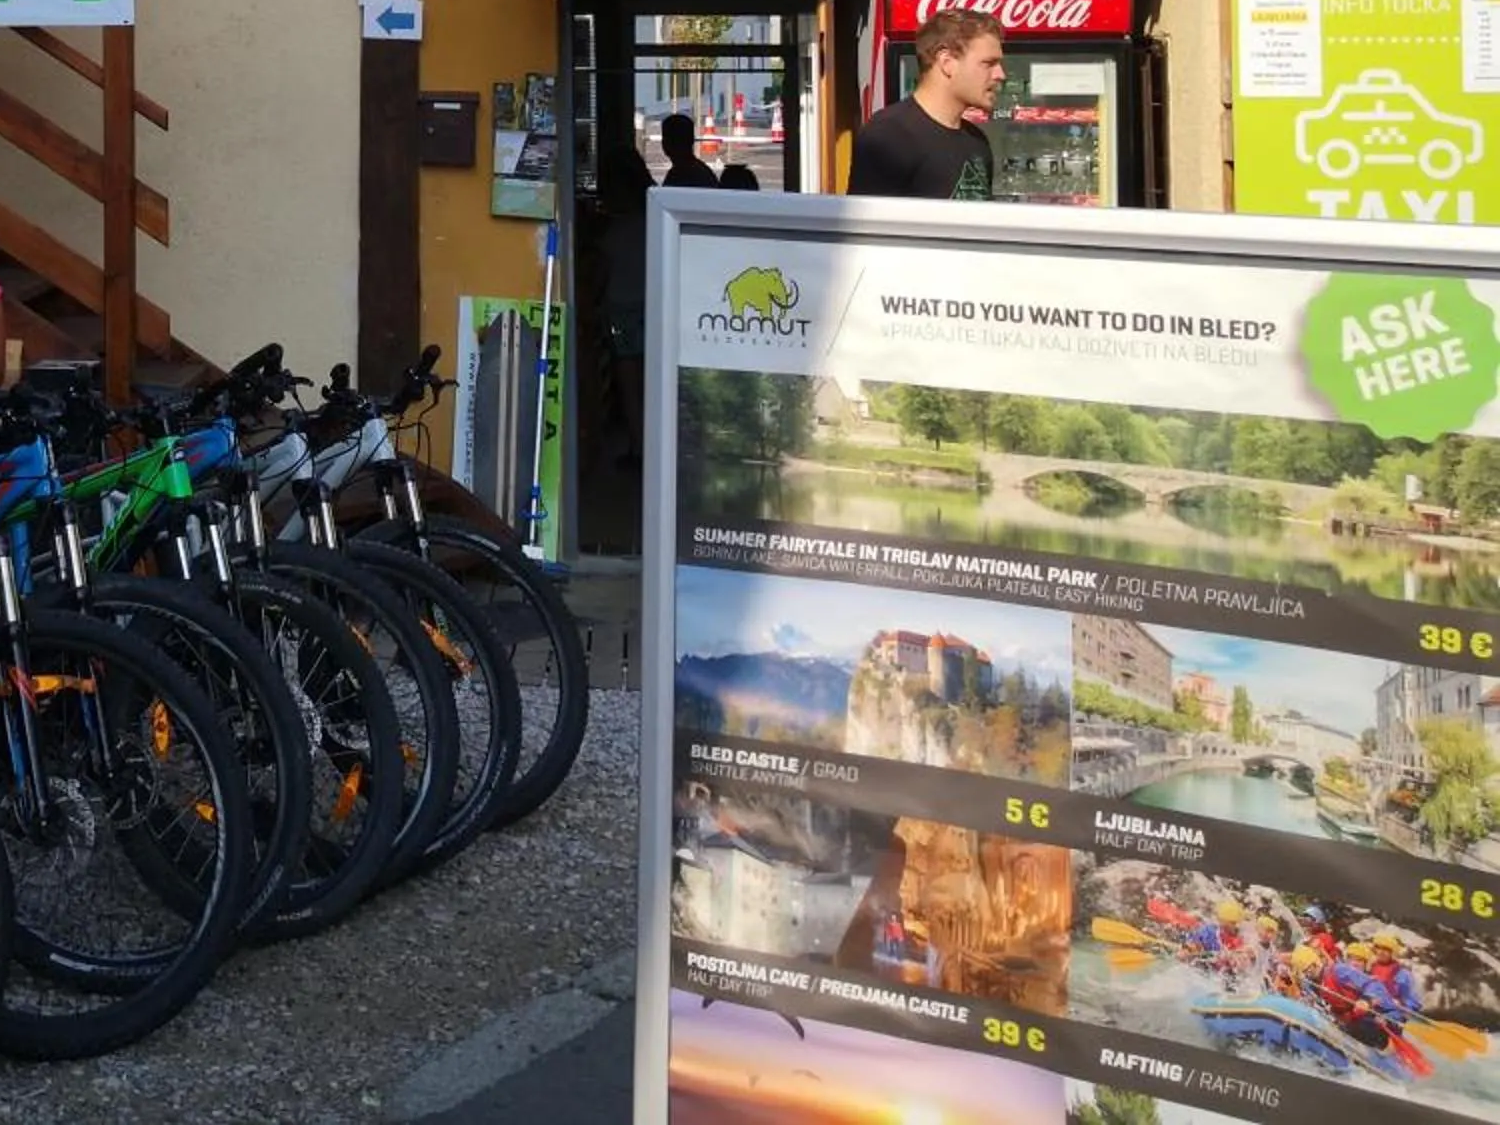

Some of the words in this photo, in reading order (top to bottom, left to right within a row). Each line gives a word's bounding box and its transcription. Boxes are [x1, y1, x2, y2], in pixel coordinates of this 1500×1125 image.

[699, 312, 813, 337] mamut
[881, 295, 943, 318] WHAT
[946, 300, 975, 320] DO
[979, 302, 1025, 323] YOU
[1029, 305, 1093, 329] WANT
[1097, 311, 1127, 332] TO
[1132, 313, 1164, 334] DO
[1170, 315, 1193, 336] IN
[1199, 318, 1276, 342] BLED?
[1340, 290, 1450, 363] ASK
[983, 328, 1035, 349] TUKAJ
[1039, 332, 1072, 352] KAJ
[1164, 342, 1190, 362] NA
[1194, 344, 1259, 367] BLEDU
[1355, 336, 1472, 401] HERE
[692, 527, 767, 549] SUMMER
[769, 534, 857, 559] FAIRYTALE
[859, 543, 877, 561] IN
[880, 545, 953, 571] TRIGLAV
[956, 554, 1044, 581] NATIONAL
[1047, 565, 1098, 588] PARK
[1115, 575, 1200, 603] POLETNA
[1203, 588, 1306, 619] PRAVLJICA
[912, 568, 984, 590] POKLJUKA
[1054, 586, 1092, 605] EASY
[1094, 592, 1145, 612] HIKING
[1418, 623, 1462, 654] 39
[1470, 632, 1494, 659] €
[690, 743, 733, 763] BLED
[735, 749, 800, 774] CASTLE
[812, 761, 860, 783] GRAD
[691, 761, 749, 781] SHUTTLE
[1004, 797, 1024, 825] 5
[1029, 804, 1050, 829] €
[1094, 809, 1206, 847] LJUBLJANA
[1094, 829, 1135, 850] HALF
[1137, 837, 1166, 856] DAY
[1170, 843, 1205, 862] TRIP
[1420, 878, 1464, 911] 28
[1470, 890, 1494, 918] €
[687, 969, 718, 987] HALF
[718, 976, 743, 993] DAY
[687, 951, 768, 984] POSTOJNA
[768, 968, 810, 991] CAVE
[819, 978, 907, 1011] PREDJAMA
[908, 995, 972, 1024] CASTLE
[982, 1017, 1020, 1047] 39
[1026, 1026, 1046, 1052] €
[1100, 1048, 1184, 1082] RAFTING
[1198, 1070, 1281, 1108] RAFTING
